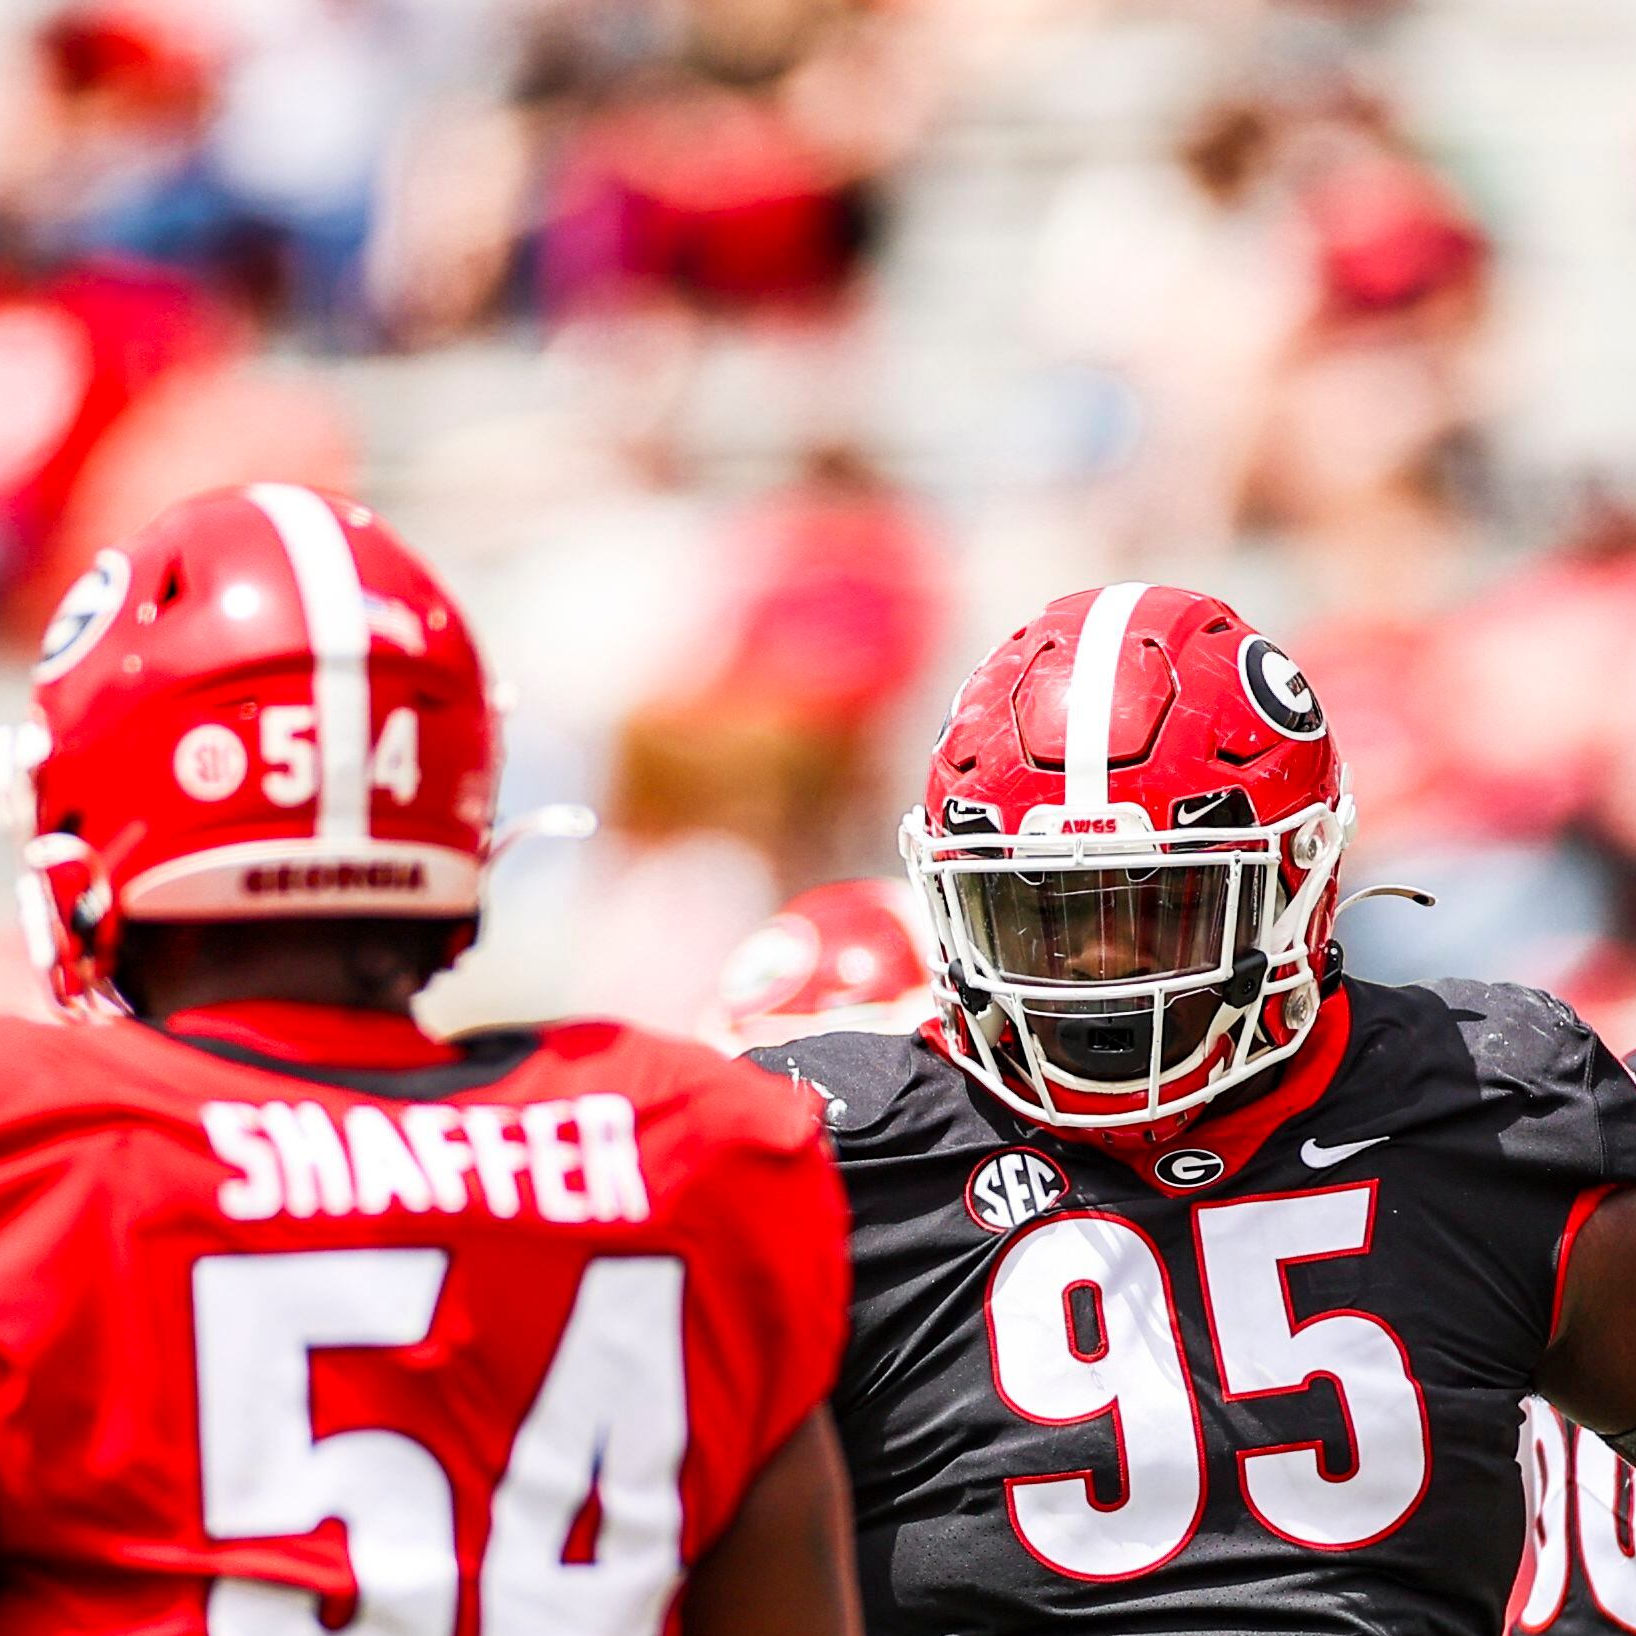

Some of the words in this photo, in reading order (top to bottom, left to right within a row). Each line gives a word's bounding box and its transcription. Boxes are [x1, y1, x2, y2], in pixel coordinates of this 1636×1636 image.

[1243, 637, 1324, 734] G
[201, 1093, 650, 1223] SHAFFER
[973, 1153, 1061, 1229] SEC
[1156, 1150, 1223, 1187] G
[984, 1179, 1433, 1584] 95
